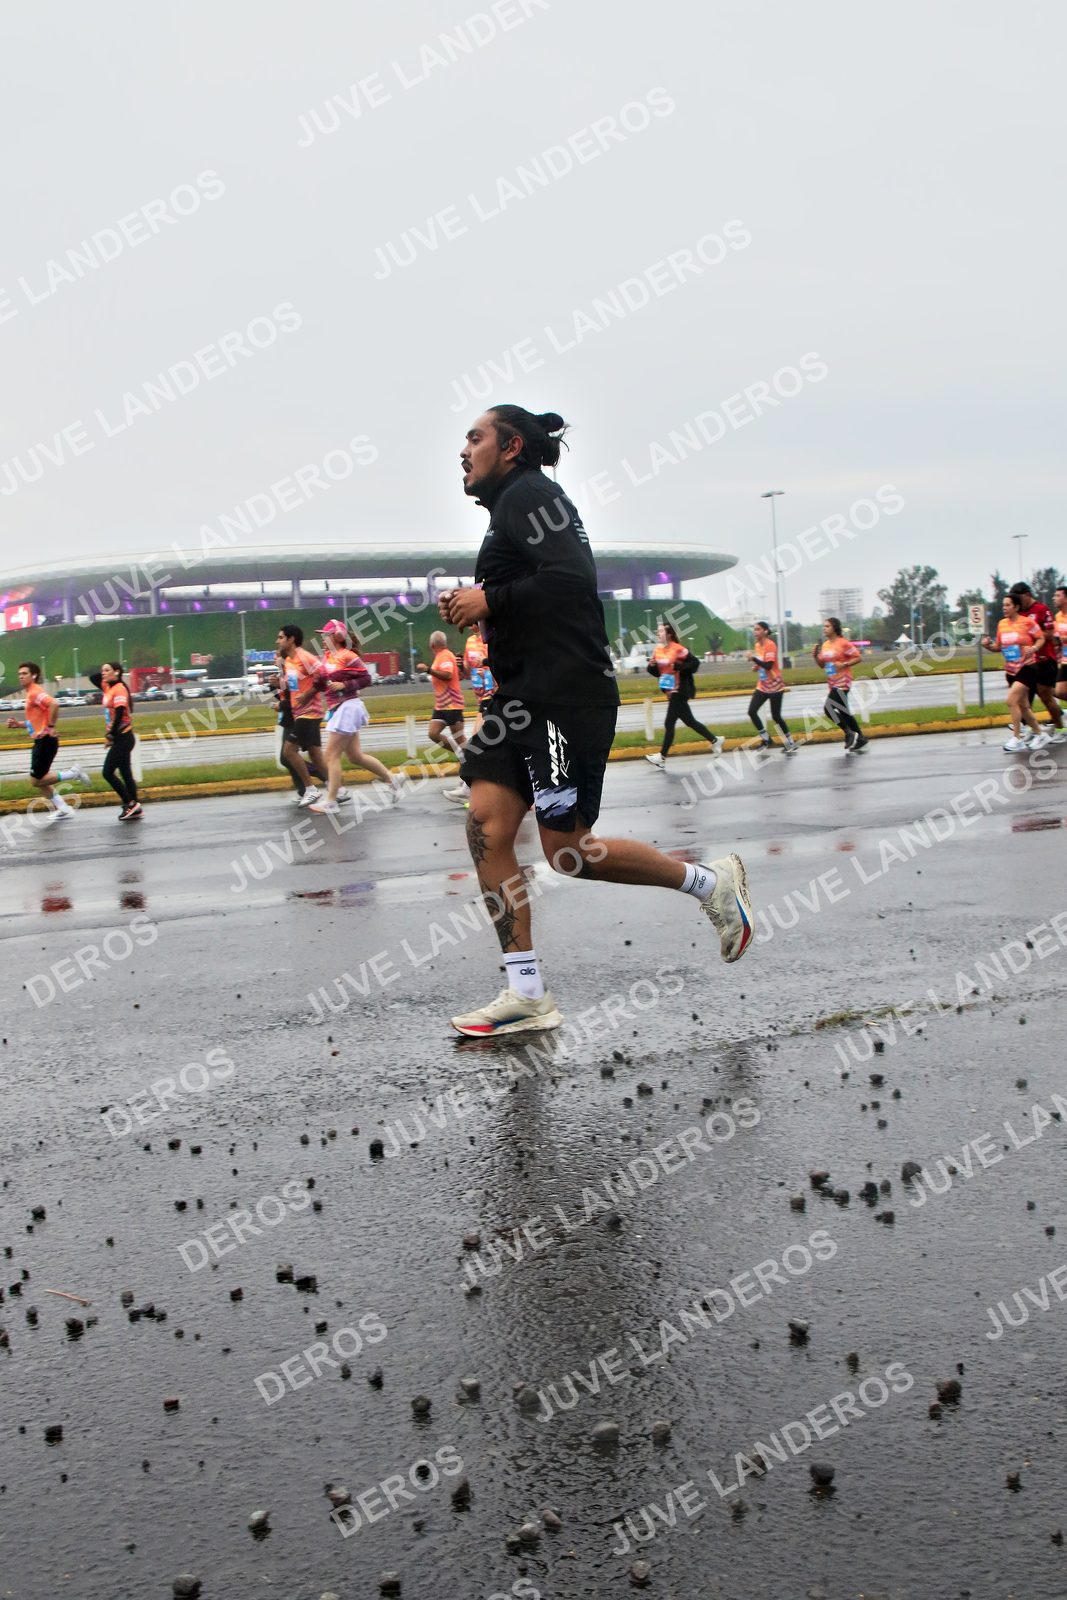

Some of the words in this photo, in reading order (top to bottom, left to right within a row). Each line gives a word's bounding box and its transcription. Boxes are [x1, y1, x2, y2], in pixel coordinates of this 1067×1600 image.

[546, 719, 559, 786] NIKE
[698, 875, 707, 889] alo
[520, 967, 536, 975] alo
